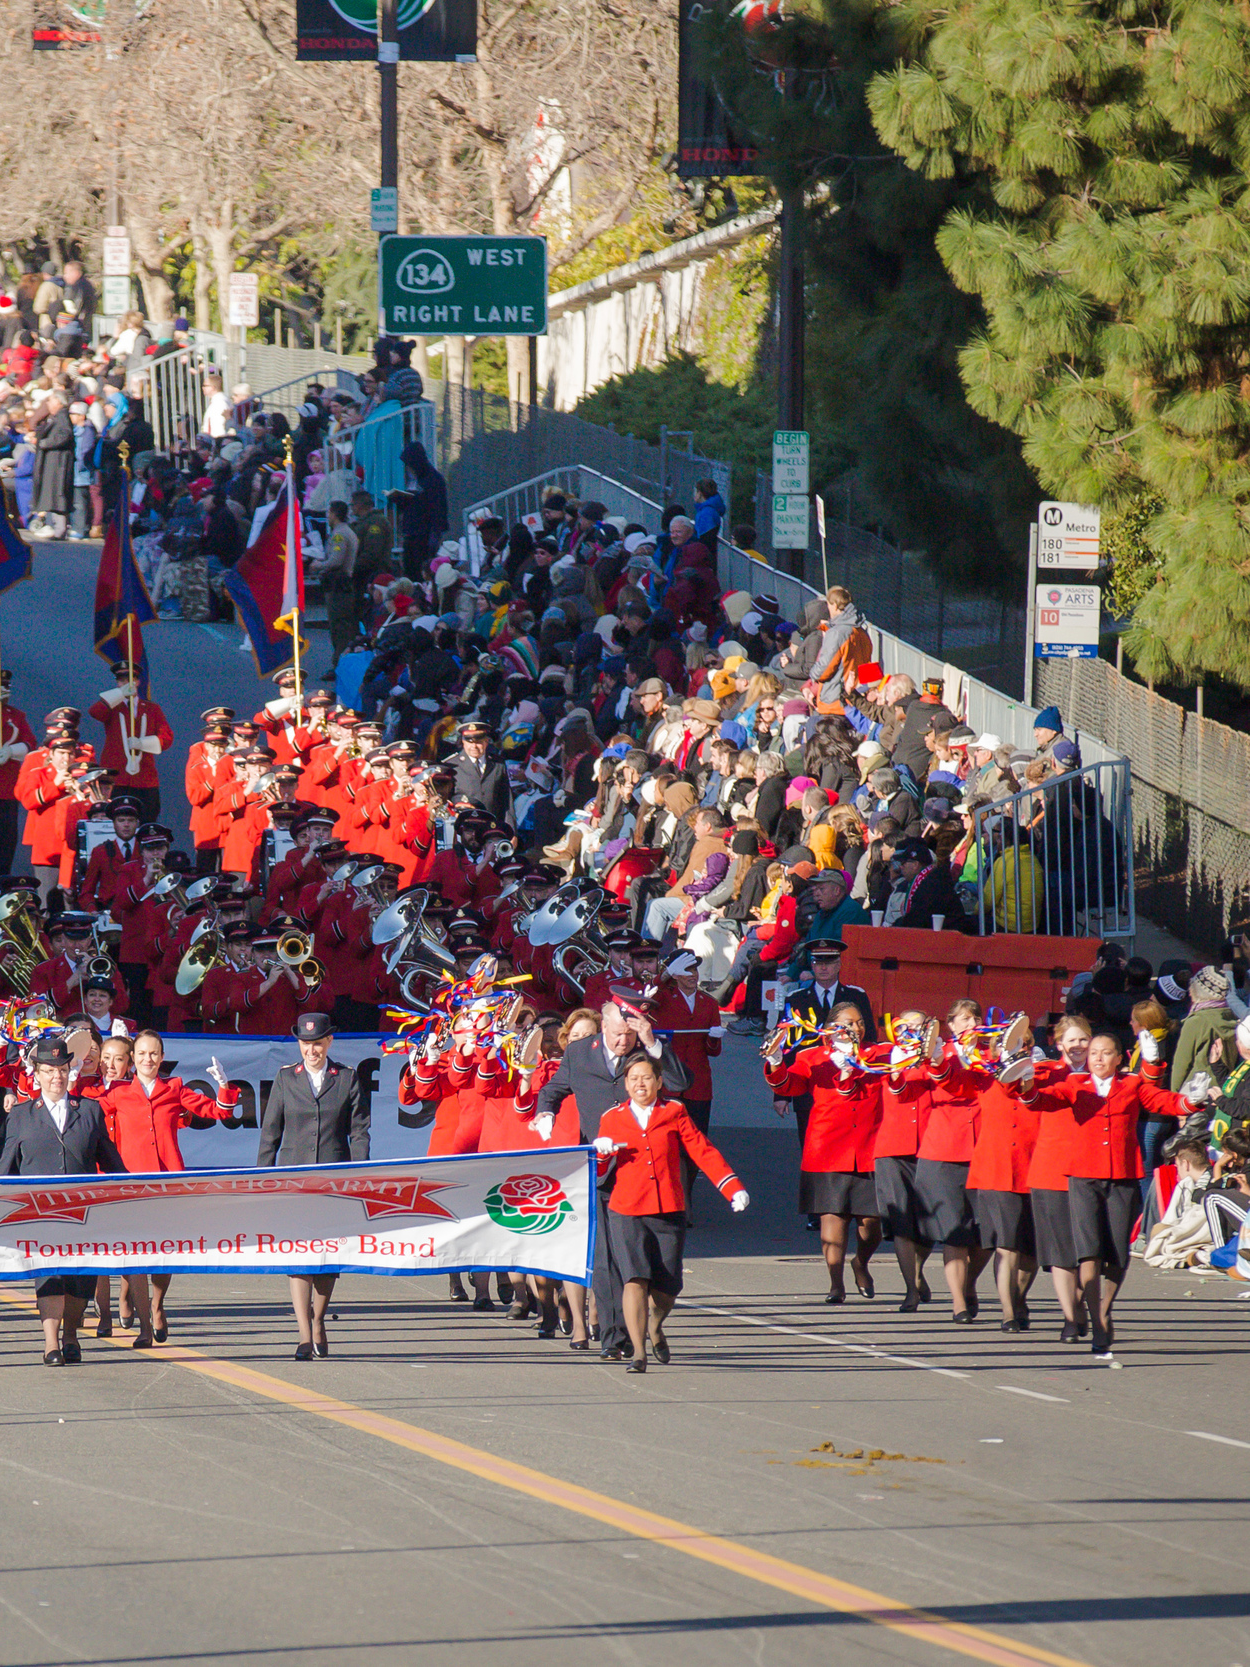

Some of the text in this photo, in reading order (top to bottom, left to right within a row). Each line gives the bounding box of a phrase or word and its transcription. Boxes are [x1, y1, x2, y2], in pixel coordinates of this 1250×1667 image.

[299, 38, 376, 49] HONDA
[681, 148, 759, 162] HOND
[467, 249, 526, 266] WEST
[405, 263, 447, 286] 134
[393, 305, 534, 323] RIGHT LANE
[776, 433, 807, 444] BEGIN
[781, 446, 801, 455] TURN
[786, 468, 796, 477] TO
[780, 479, 801, 488] CURB
[775, 498, 785, 510] 2
[776, 514, 806, 524] PARKING
[1066, 523, 1096, 532] Metro
[1042, 539, 1063, 549] 180
[1041, 553, 1060, 563] 181
[1065, 594, 1094, 605] ARTS
[1043, 612, 1058, 624] 10
[37, 1179, 412, 1206] THE SALVATION ARMY
[17, 1236, 208, 1259] Tournament
[217, 1233, 247, 1254] of
[358, 1234, 436, 1258] Band
